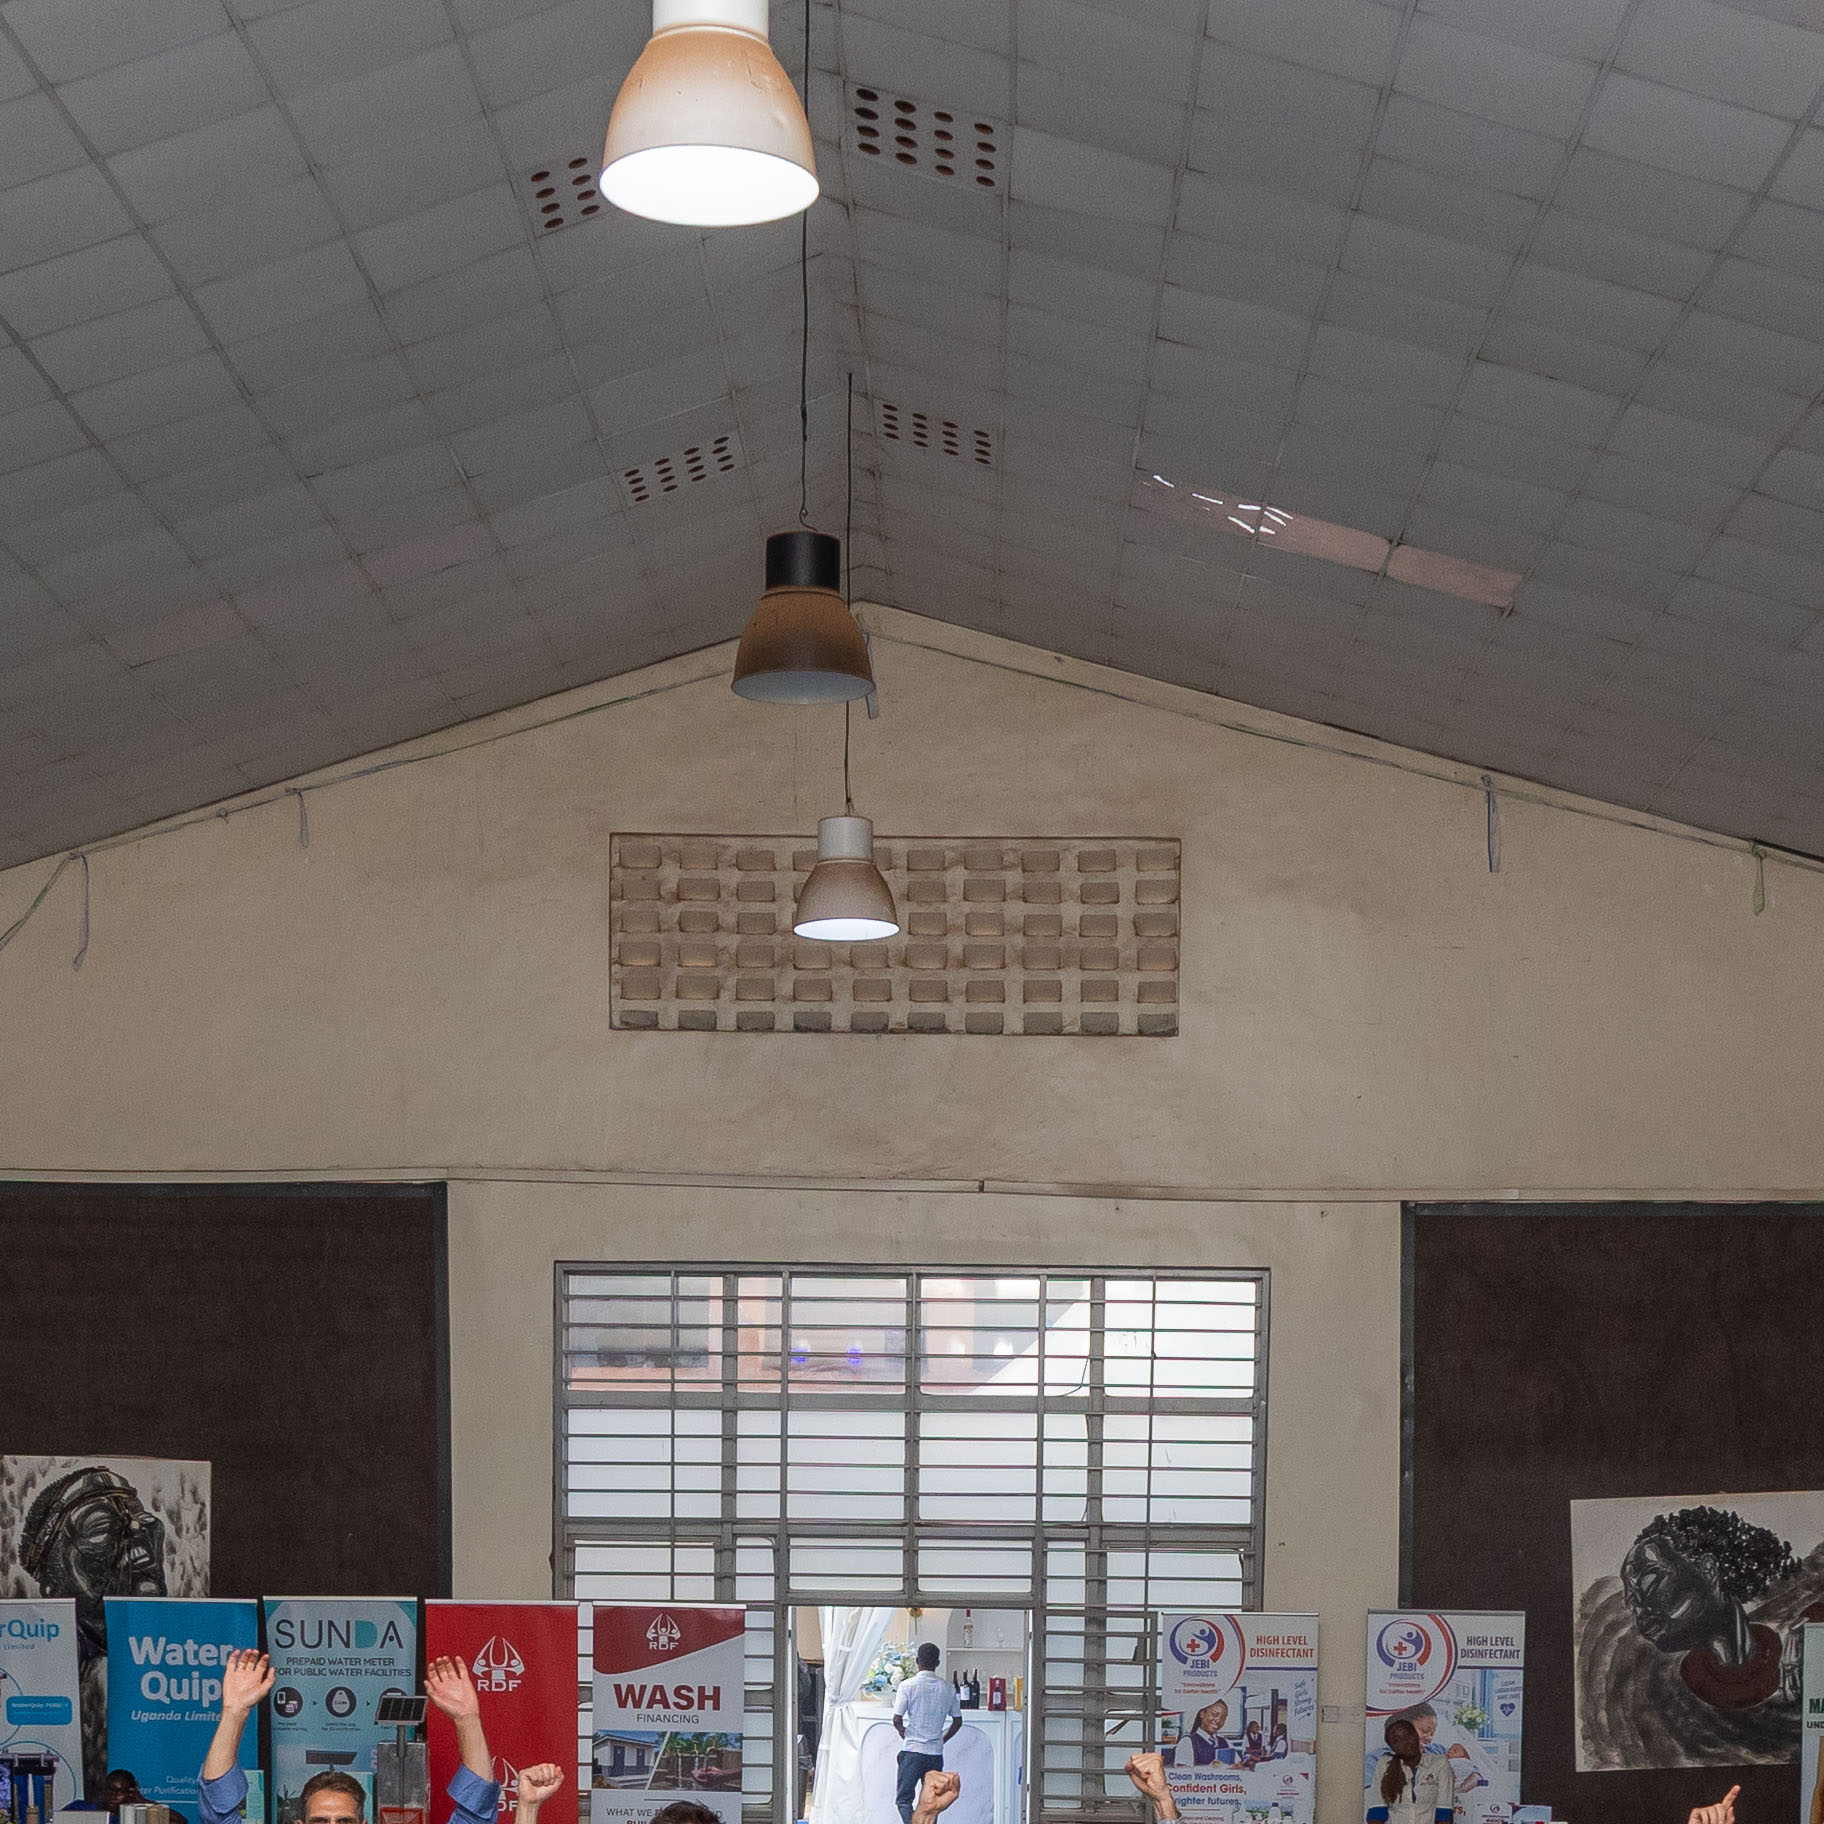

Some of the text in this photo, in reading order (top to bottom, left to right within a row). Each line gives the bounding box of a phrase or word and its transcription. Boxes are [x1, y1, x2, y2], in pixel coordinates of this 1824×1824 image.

[275, 1618, 404, 1649] SUNDA
[648, 1641, 678, 1651] RDF
[1256, 1635, 1309, 1646] HIGH LEVEL
[1466, 1636, 1515, 1647] HIGH LEVEL
[128, 1636, 234, 1666] Water
[1249, 1647, 1314, 1659] DISINFECTANT
[1460, 1648, 1521, 1660] DISINFECTANT
[286, 1657, 395, 1666] PREPAID WATER METER
[1189, 1659, 1210, 1669] JEBI
[1396, 1662, 1417, 1672] JEBI
[294, 1667, 326, 1676] PUBLIC
[329, 1667, 363, 1677] WATER
[364, 1667, 412, 1677] FACILITIES
[1183, 1669, 1218, 1678] PRODUCTS
[140, 1671, 223, 1707] Quip
[477, 1679, 522, 1692] RDF
[612, 1683, 721, 1711] WASH
[131, 1710, 222, 1723] Uganda Limite
[636, 1713, 700, 1724] FINANCING
[1168, 1772, 1193, 1781] Clean
[1219, 1783, 1247, 1795] Girls,
[497, 1801, 518, 1812] DF
[1174, 1796, 1206, 1807] righter
[606, 1808, 634, 1818] WHAT
[637, 1808, 653, 1818] WE
